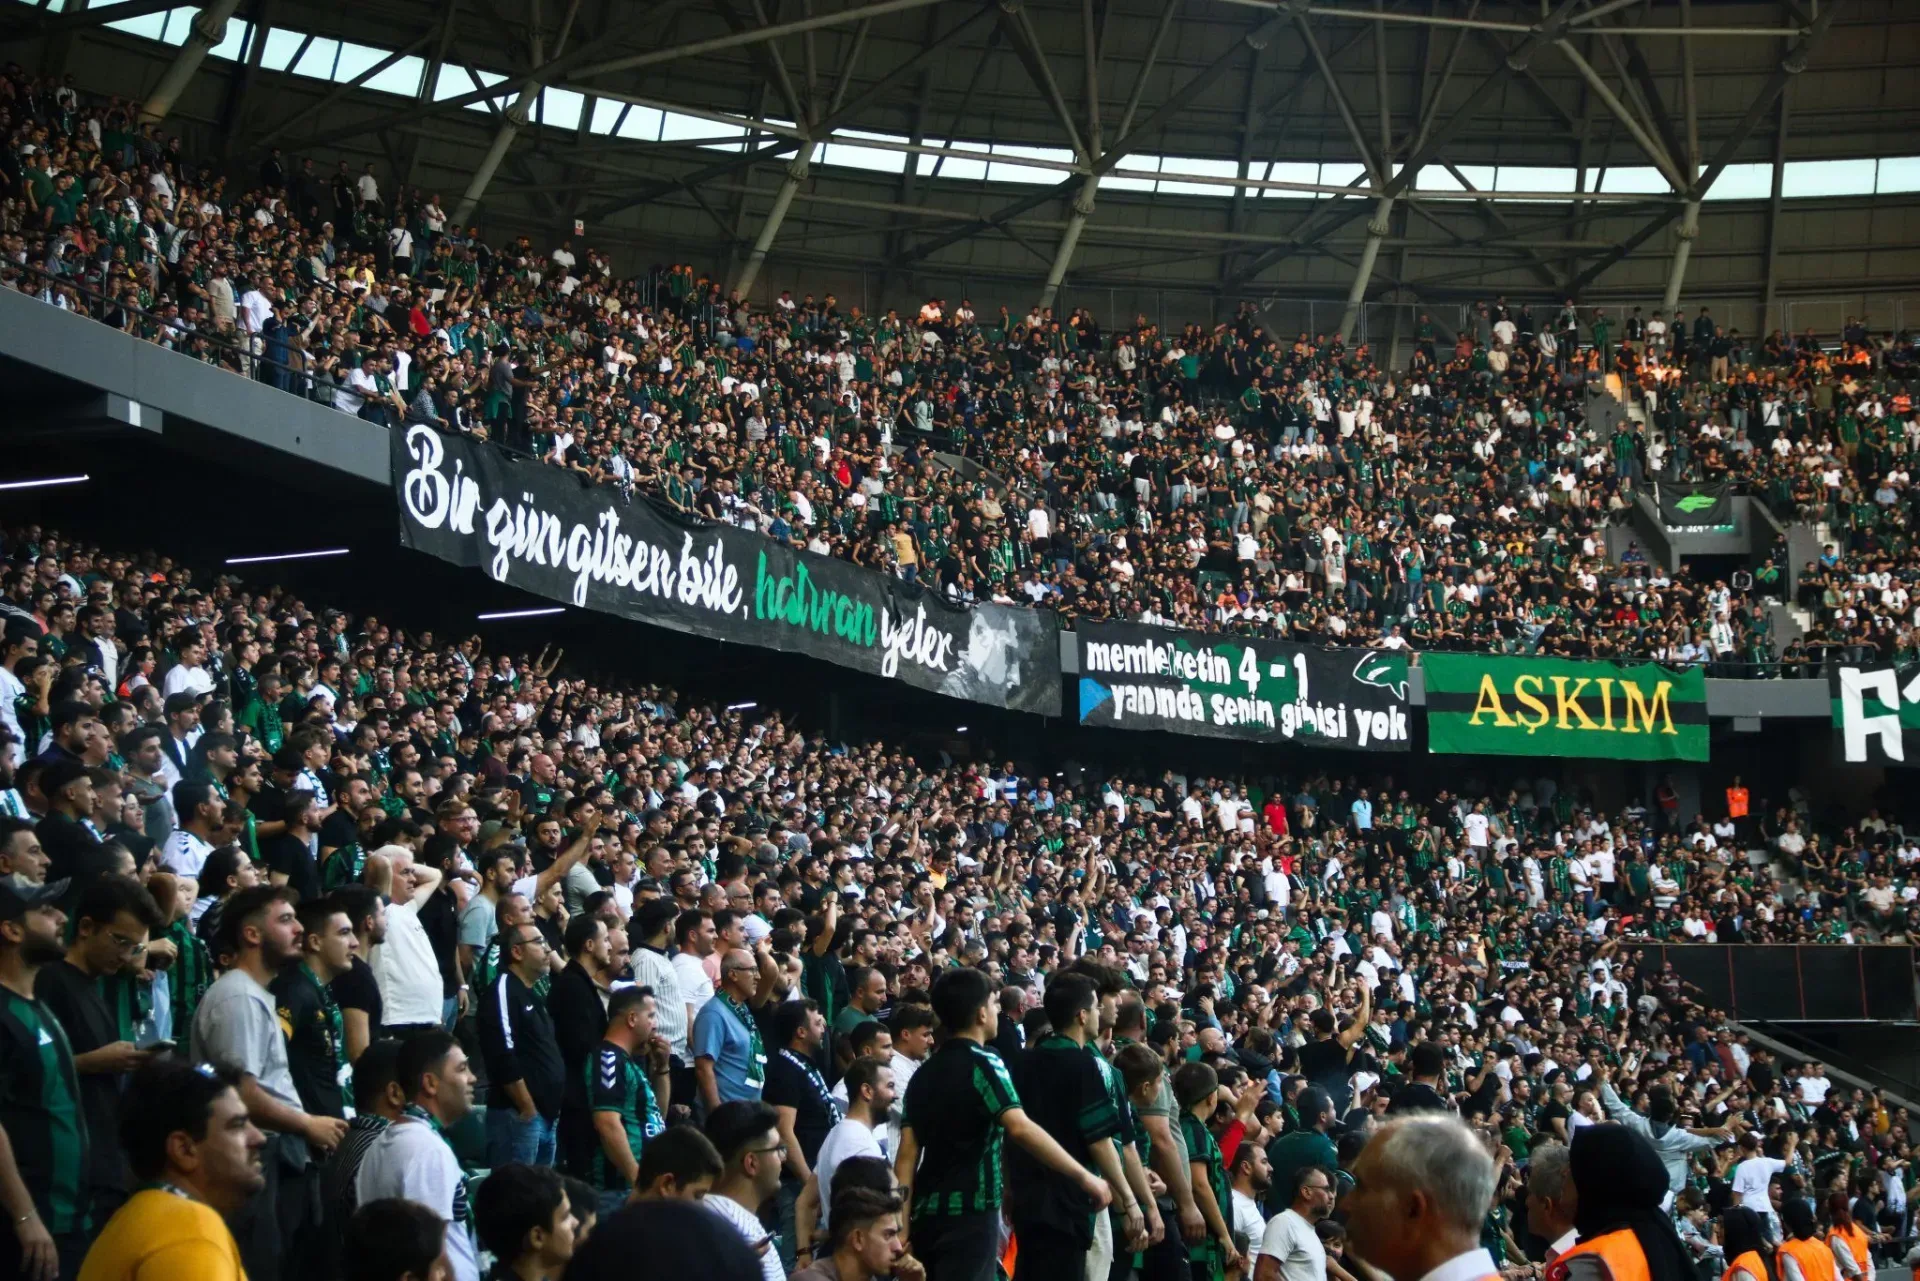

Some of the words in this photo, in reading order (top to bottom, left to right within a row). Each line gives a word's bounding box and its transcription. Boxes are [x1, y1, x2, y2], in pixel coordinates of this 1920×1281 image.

[486, 491, 566, 582] gün
[567, 506, 676, 607] gitsen
[755, 549, 877, 647] hatıran
[881, 602, 953, 677] yeter
[1087, 640, 1231, 684] memleketin
[1239, 647, 1260, 693] 4
[1294, 653, 1308, 700] 1
[1110, 684, 1204, 722] yanında
[1210, 694, 1275, 728] senin
[1281, 697, 1347, 738] gibisi
[1354, 705, 1407, 746] yok
[1468, 673, 1678, 735] AŞKIM
